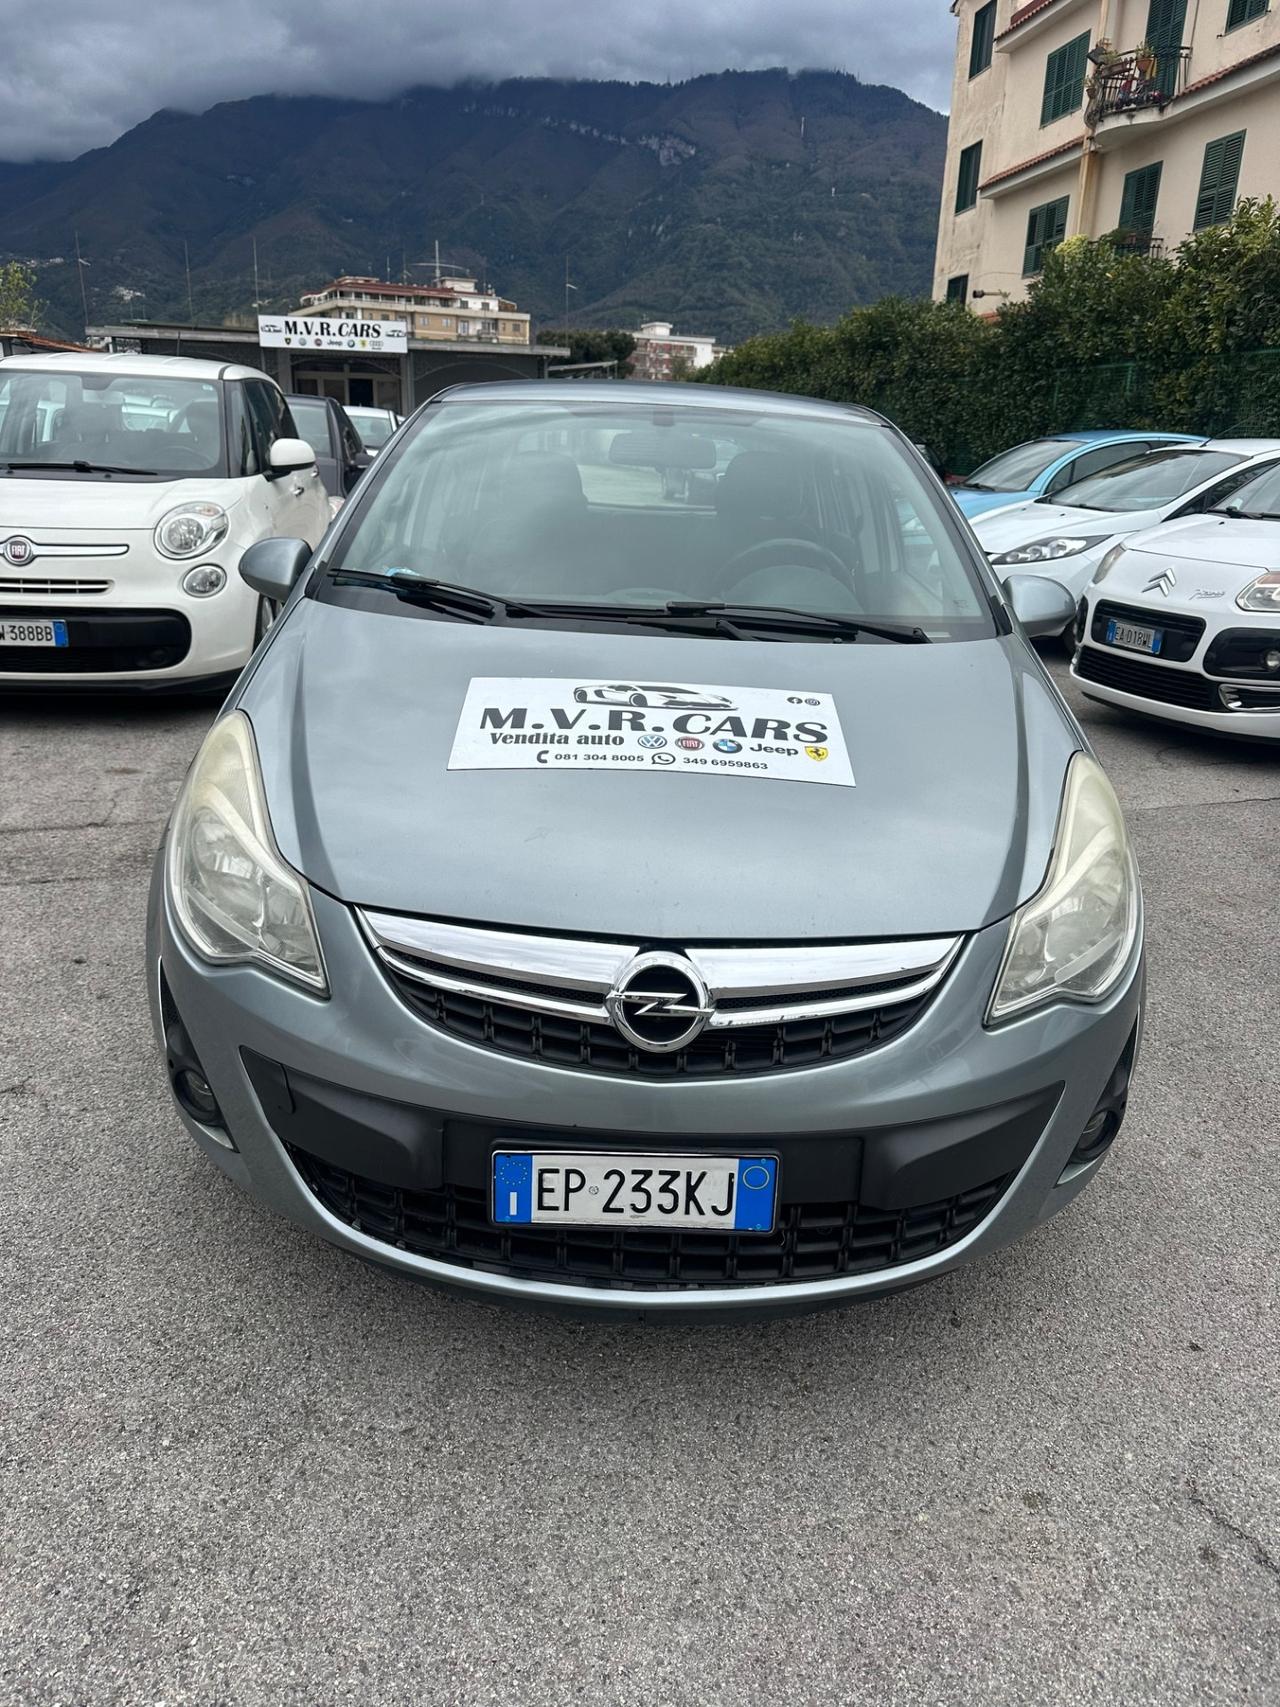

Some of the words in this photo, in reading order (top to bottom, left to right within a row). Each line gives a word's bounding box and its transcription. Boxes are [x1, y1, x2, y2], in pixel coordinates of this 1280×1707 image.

[11, 544, 25, 556] FIAT
[8, 624, 53, 641] 388BB
[490, 732, 570, 745] Vendita
[576, 733, 625, 746] auto
[749, 743, 799, 757] Jeep
[554, 753, 578, 761] 081
[583, 753, 607, 761] 304
[611, 754, 645, 762] 8005
[682, 757, 708, 766] 349
[711, 758, 769, 770] 6959863
[537, 1167, 587, 1212] EP
[602, 1168, 735, 1217] 233KJ
